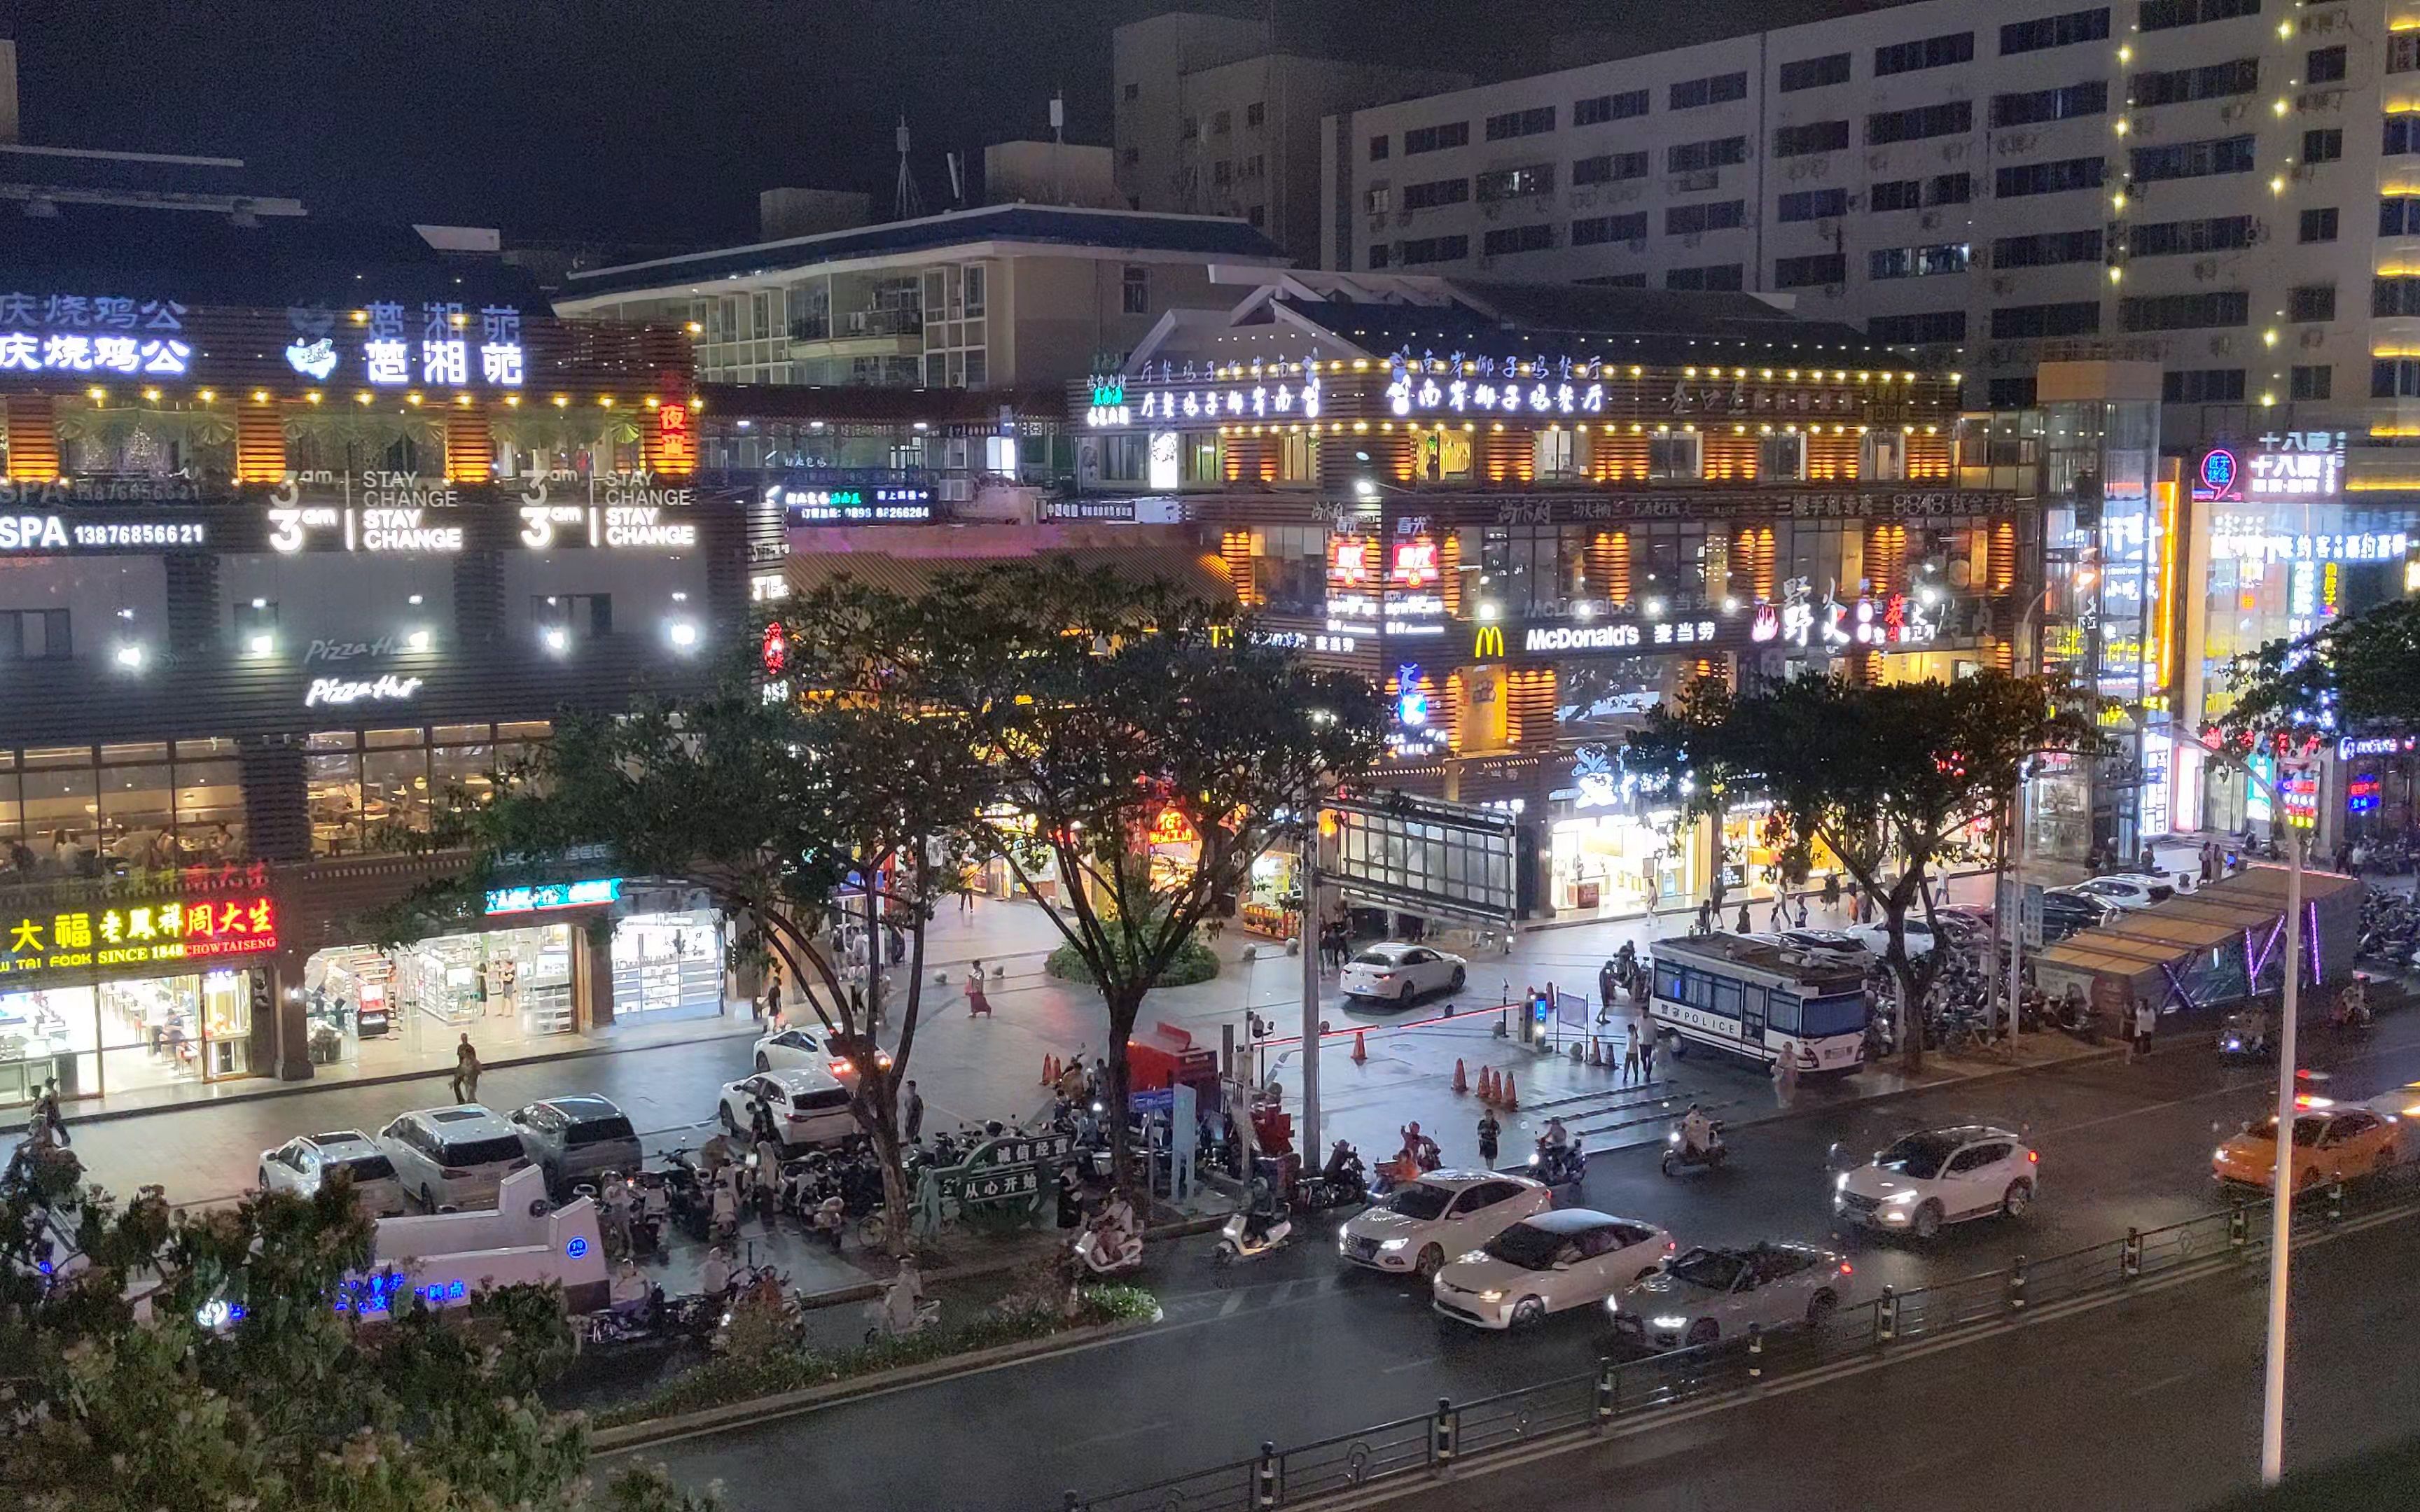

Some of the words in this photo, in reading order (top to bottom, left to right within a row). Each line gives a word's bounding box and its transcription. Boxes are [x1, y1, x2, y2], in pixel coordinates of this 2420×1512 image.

[363, 508, 421, 529] STAY
[605, 507, 660, 526] STAY
[363, 528, 463, 550] CHANGE
[605, 526, 695, 545] CHANGE
[1526, 625, 1640, 650] McDonald's
[1655, 622, 1716, 643] 麦当劳
[305, 677, 373, 707] Pizza
[373, 675, 424, 699] Hut
[185, 898, 274, 937] 周大生
[98, 947, 148, 965] SINCE
[151, 944, 184, 960] 1848
[185, 942, 221, 955] CHOW
[15, 958, 41, 971] TAI
[50, 952, 92, 968] FOOK
[1684, 1012, 1734, 1033] POLICE
[997, 1139, 1068, 1163] 诚信经营
[965, 1173, 1037, 1198] 从心开始
